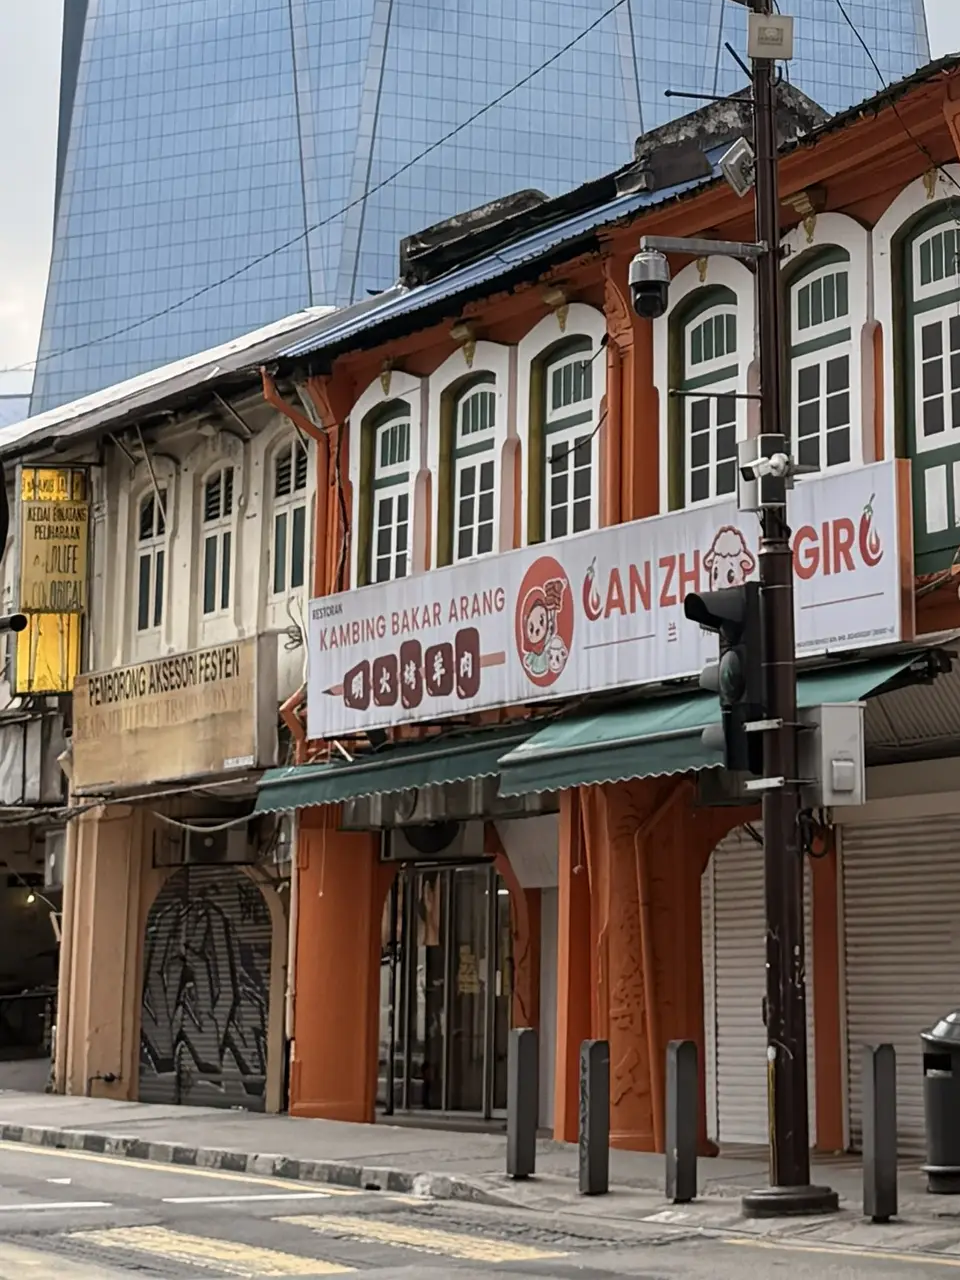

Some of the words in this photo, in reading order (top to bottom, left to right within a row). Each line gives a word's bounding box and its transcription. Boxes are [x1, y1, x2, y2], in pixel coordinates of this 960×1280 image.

[312, 604, 343, 620] RESTORAN
[320, 614, 386, 652] KAMBING
[391, 602, 442, 636] BAKAR
[448, 587, 505, 624] ARANG
[88, 666, 147, 707] PEMBORONG
[148, 655, 197, 695] AKSESORI
[198, 644, 240, 684] FESYEN
